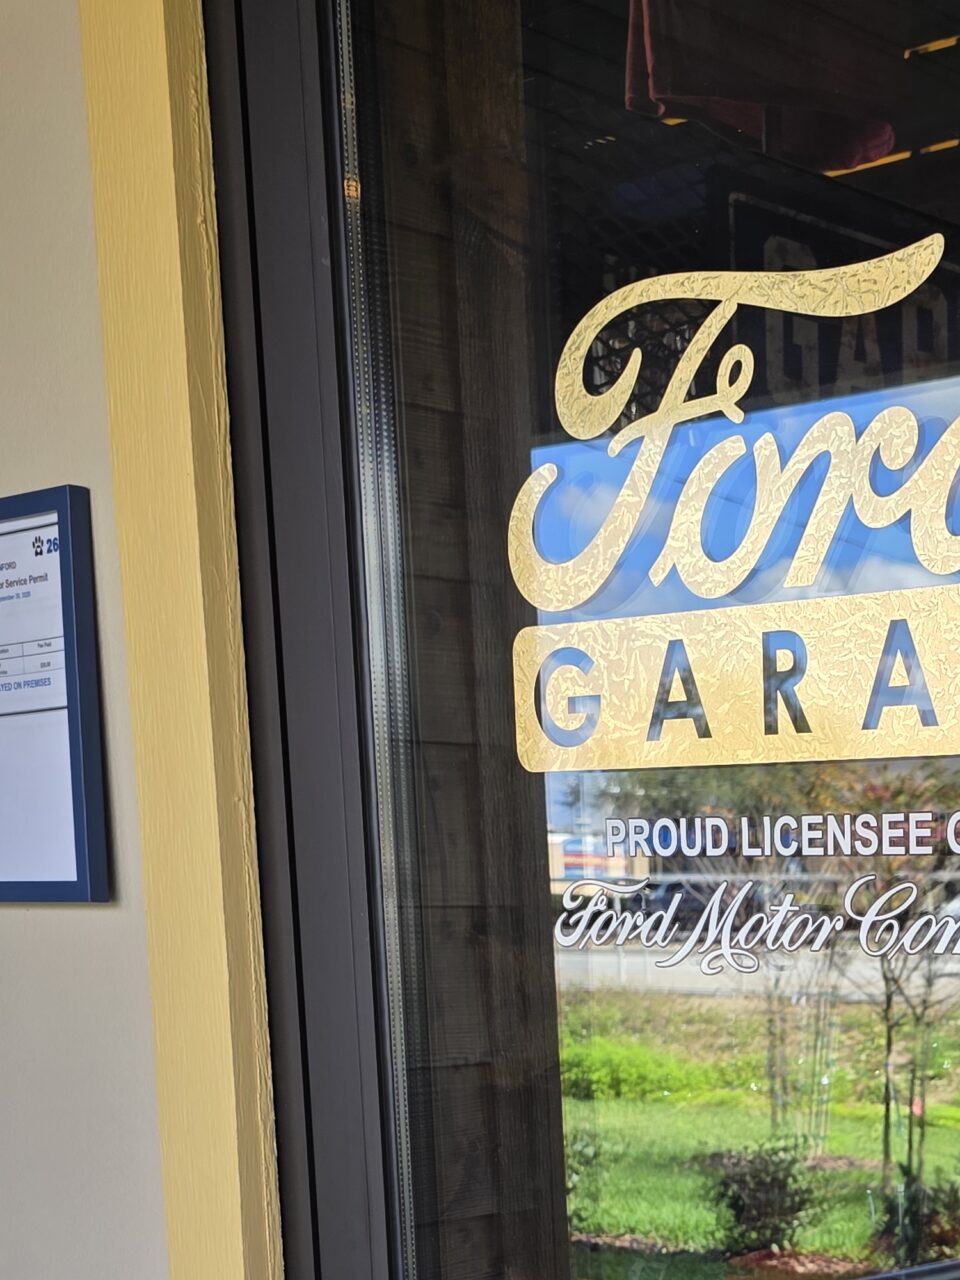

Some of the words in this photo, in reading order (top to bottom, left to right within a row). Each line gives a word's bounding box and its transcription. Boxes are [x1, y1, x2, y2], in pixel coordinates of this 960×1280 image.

[46, 537, 59, 554] 26
[5, 577, 27, 589] Service
[29, 572, 48, 584] Permit
[604, 815, 729, 857] PROUD
[741, 811, 933, 857] LICENSEE
[554, 876, 685, 949] Ford
[656, 879, 844, 976] Motor
